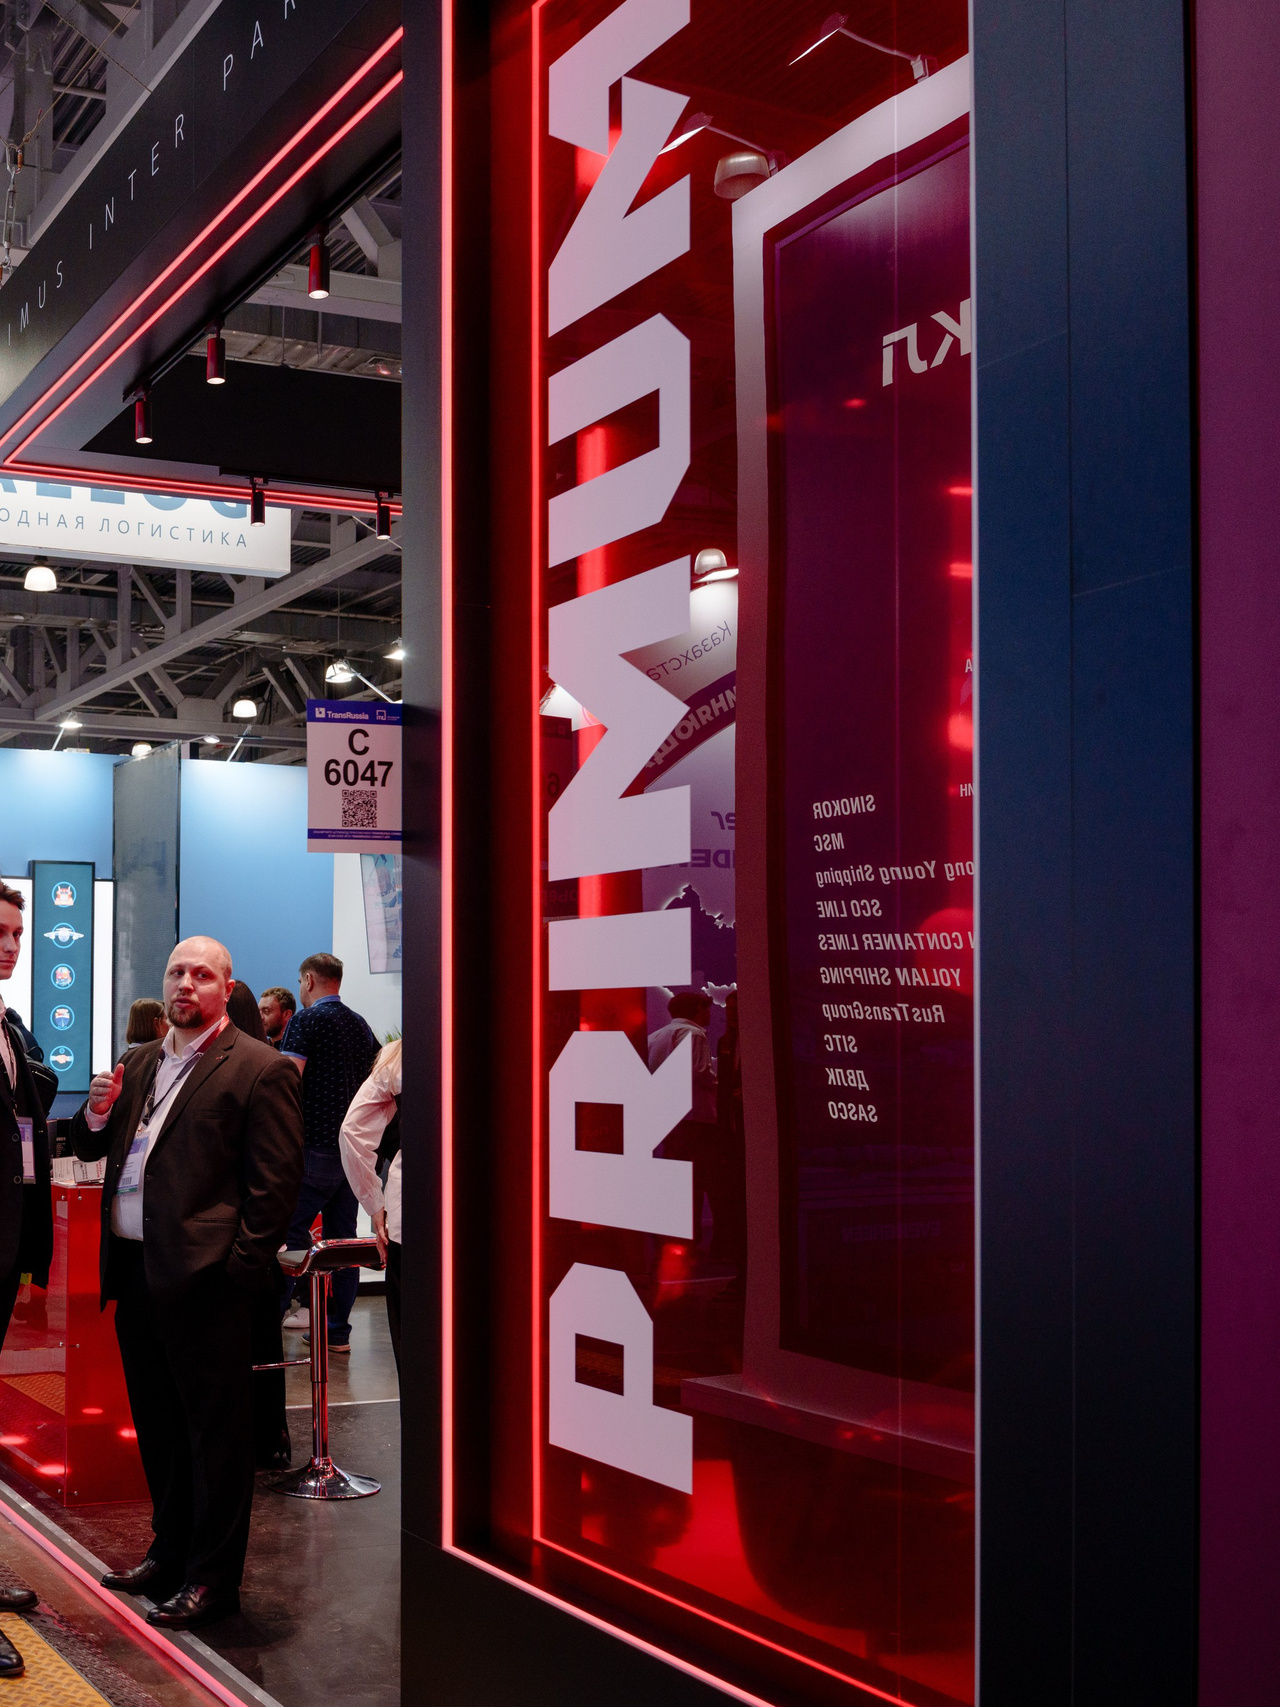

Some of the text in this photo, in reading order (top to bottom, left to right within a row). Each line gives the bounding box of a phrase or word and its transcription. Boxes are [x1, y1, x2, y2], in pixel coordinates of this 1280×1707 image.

[88, 113, 185, 250] INTER
[98, 517, 248, 548] ЛОГИСТИКА
[326, 710, 370, 720] TransRussia
[548, 0, 694, 1495] PRIMUM
[323, 758, 394, 787] 6047
